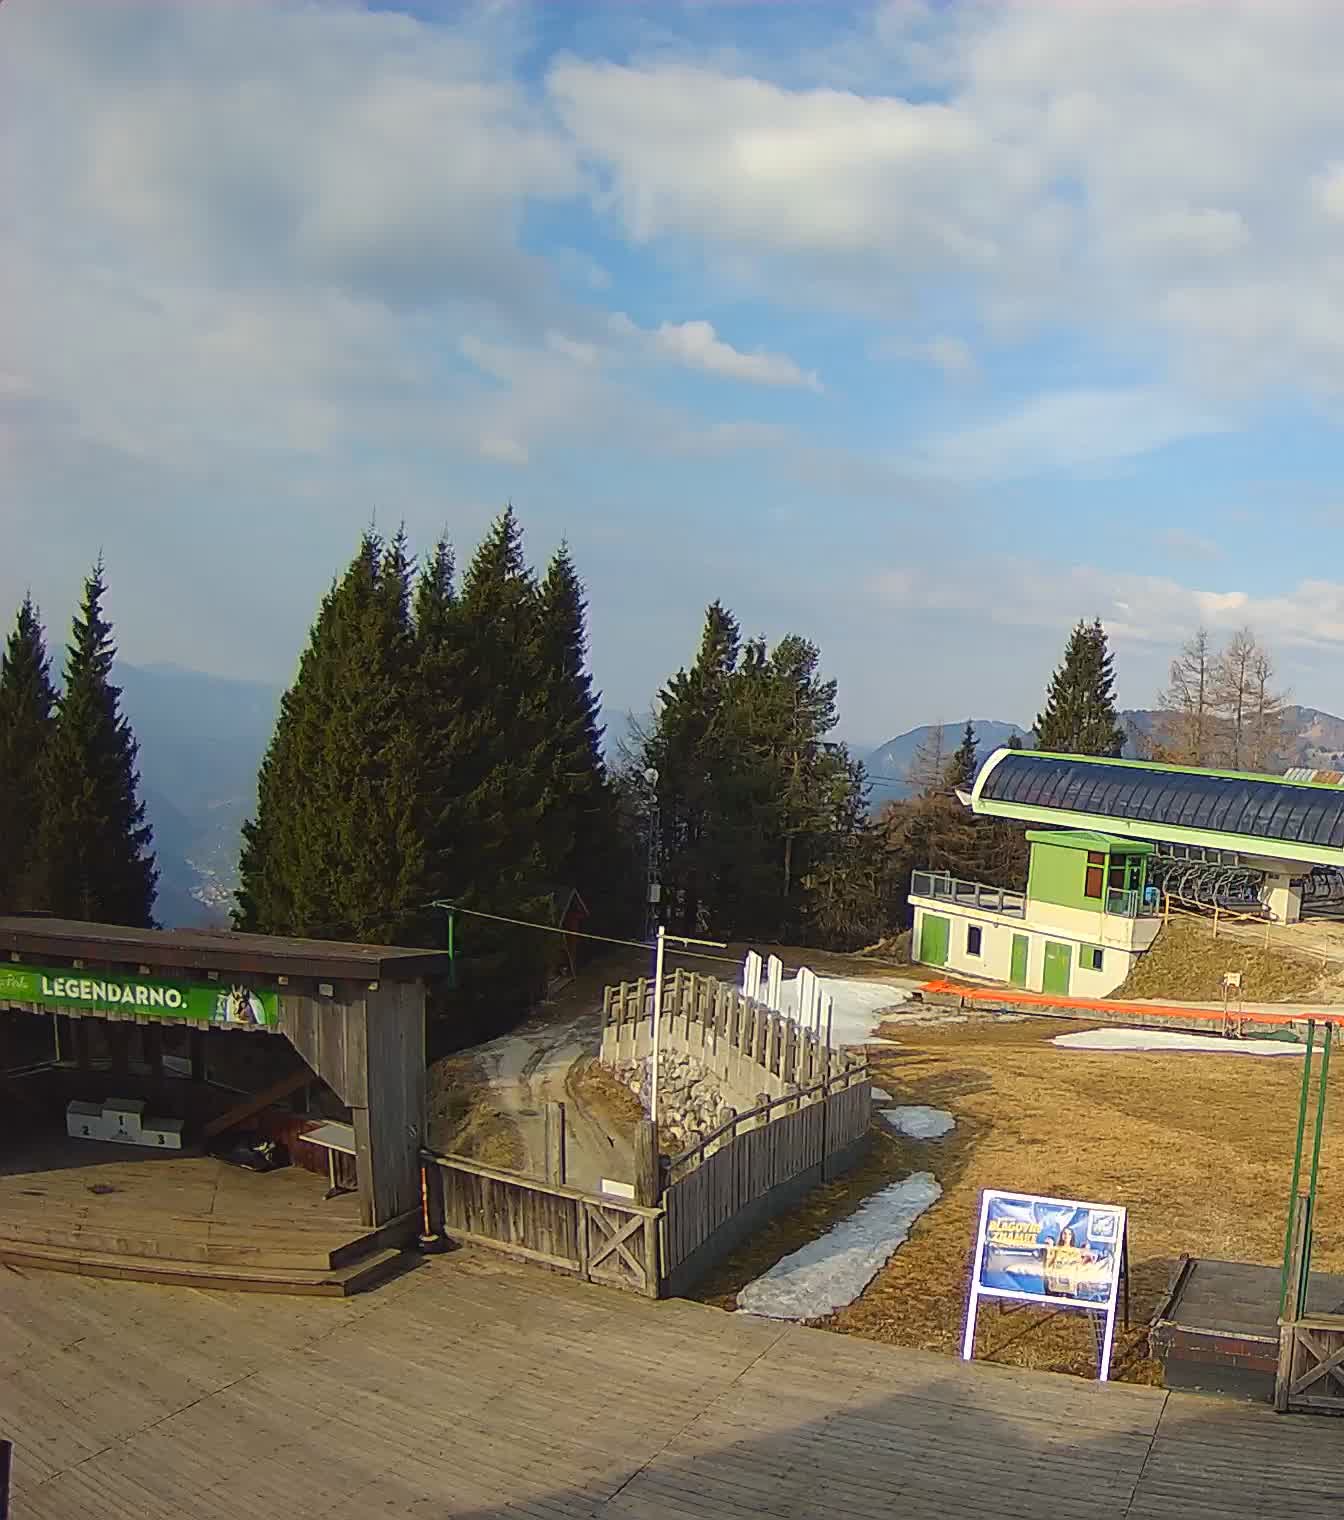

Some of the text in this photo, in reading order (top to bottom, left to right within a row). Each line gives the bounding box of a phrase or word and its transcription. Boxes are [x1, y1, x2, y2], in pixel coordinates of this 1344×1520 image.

[41, 976, 188, 1009] LEGENDARNO.
[81, 1125, 90, 1136] 2
[157, 1134, 166, 1145] 3
